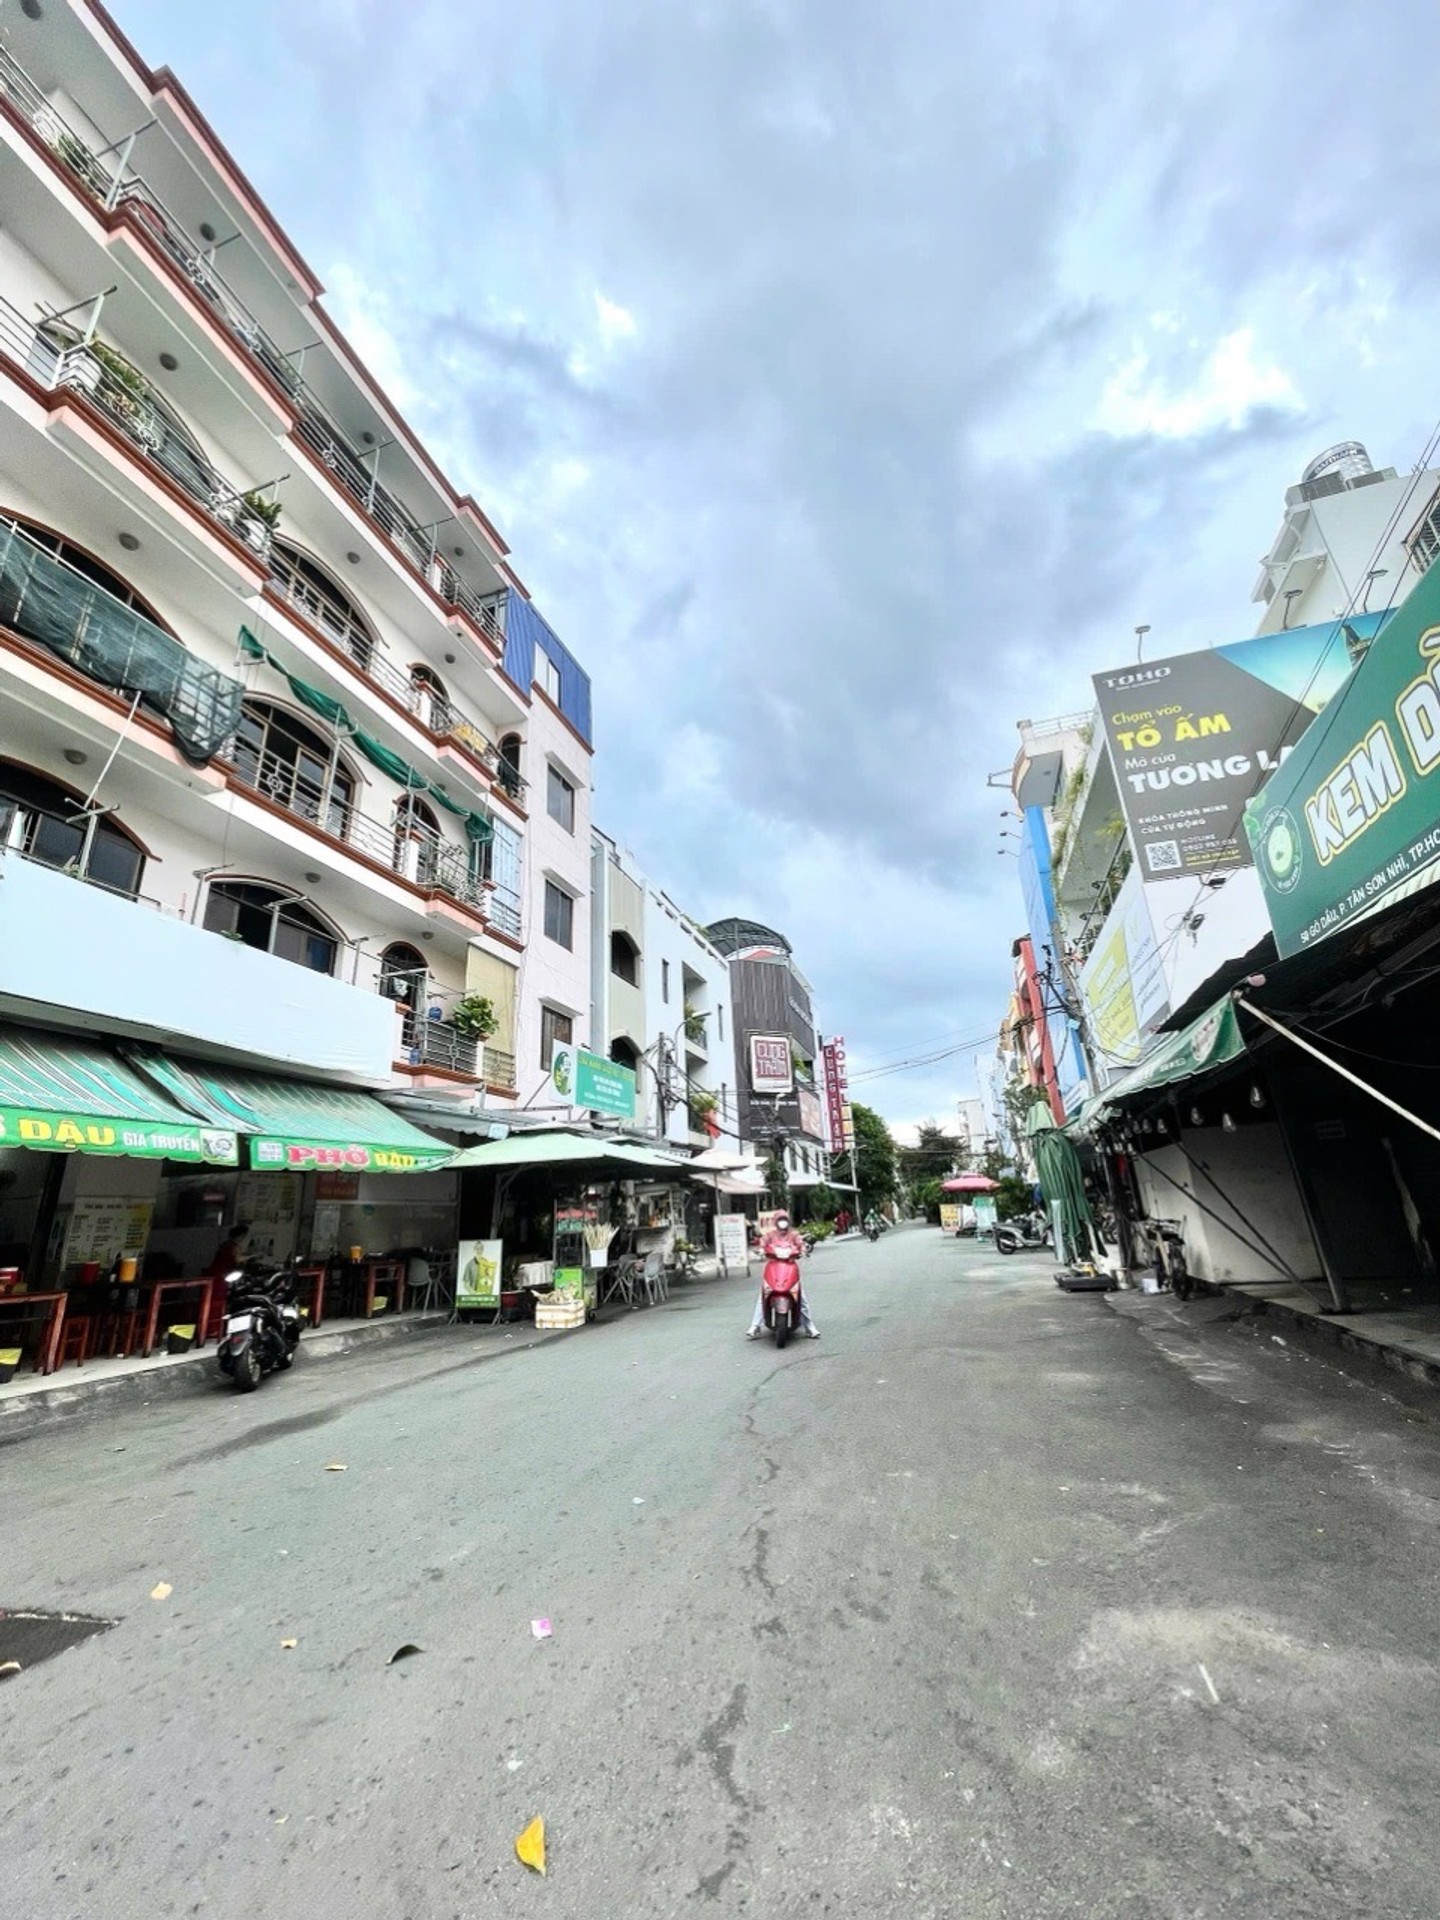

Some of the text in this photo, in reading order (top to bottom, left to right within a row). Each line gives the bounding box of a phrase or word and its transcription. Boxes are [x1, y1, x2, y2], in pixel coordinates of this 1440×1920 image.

[1112, 703, 1182, 726] Chạm vào
[1117, 713, 1232, 751] TỔ ẤM
[1128, 755, 1251, 793] TƯƠNG
[1305, 721, 1406, 865] KEM
[1346, 889, 1366, 908] TÂN
[835, 1036, 850, 1106] HOTEL
[18, 1117, 116, 1148] DẬU
[122, 1130, 147, 1147] GIA
